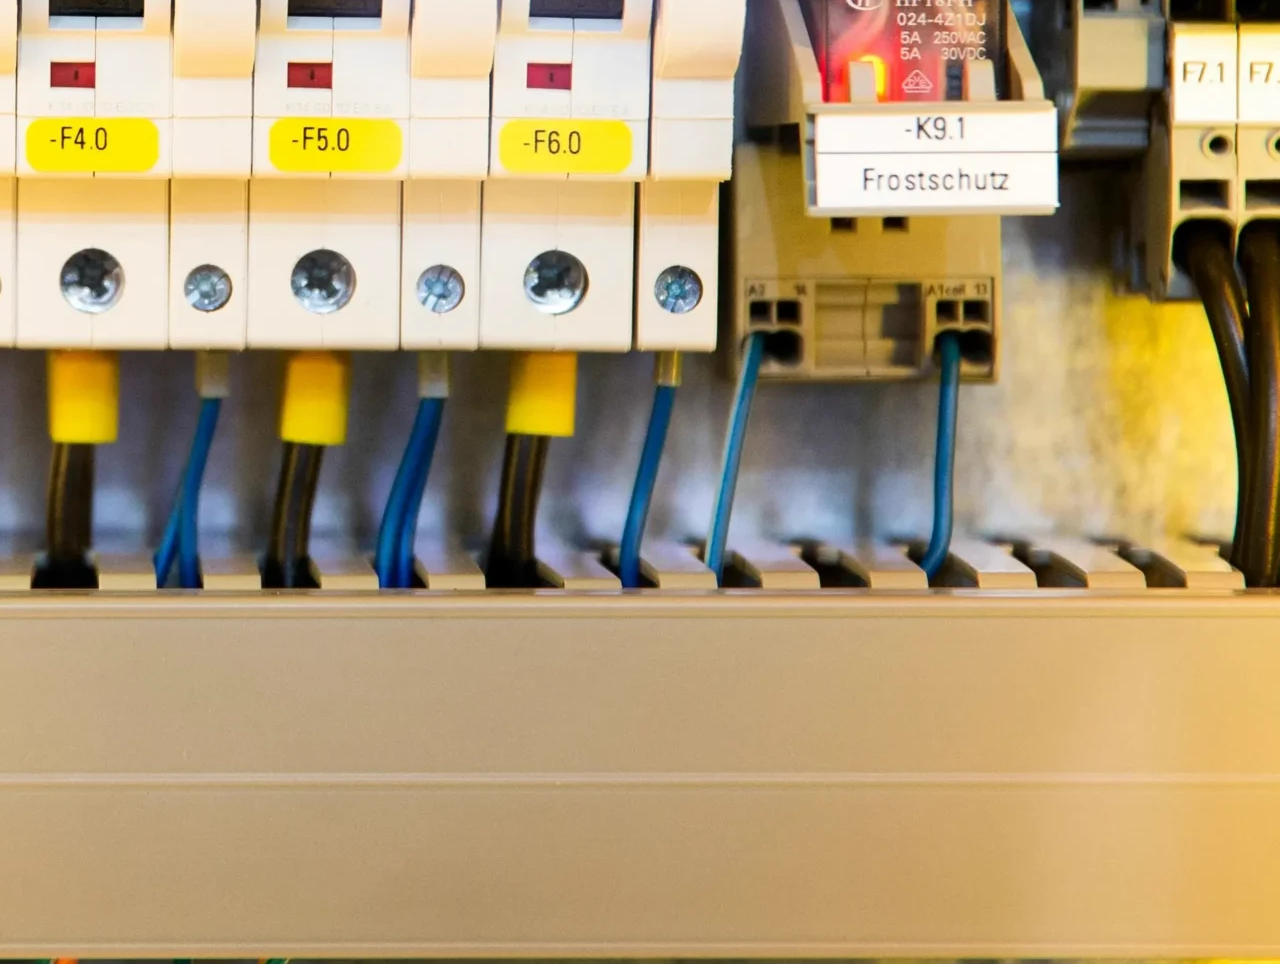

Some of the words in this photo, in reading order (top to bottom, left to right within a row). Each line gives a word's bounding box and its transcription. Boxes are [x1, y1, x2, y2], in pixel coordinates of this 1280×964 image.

[896, 12, 987, 26] 024-4Z1DJ
[900, 31, 922, 44] 5A
[933, 31, 987, 44] 250VAC
[900, 47, 922, 60] 5A
[941, 47, 987, 60] 30VDC
[1182, 61, 1225, 84] F7.1
[50, 126, 108, 151] -F4.0
[292, 127, 350, 152] -F5.0
[905, 116, 965, 140] -K9.1
[523, 130, 581, 155] -F6.0
[863, 168, 1010, 192] Frostschutz
